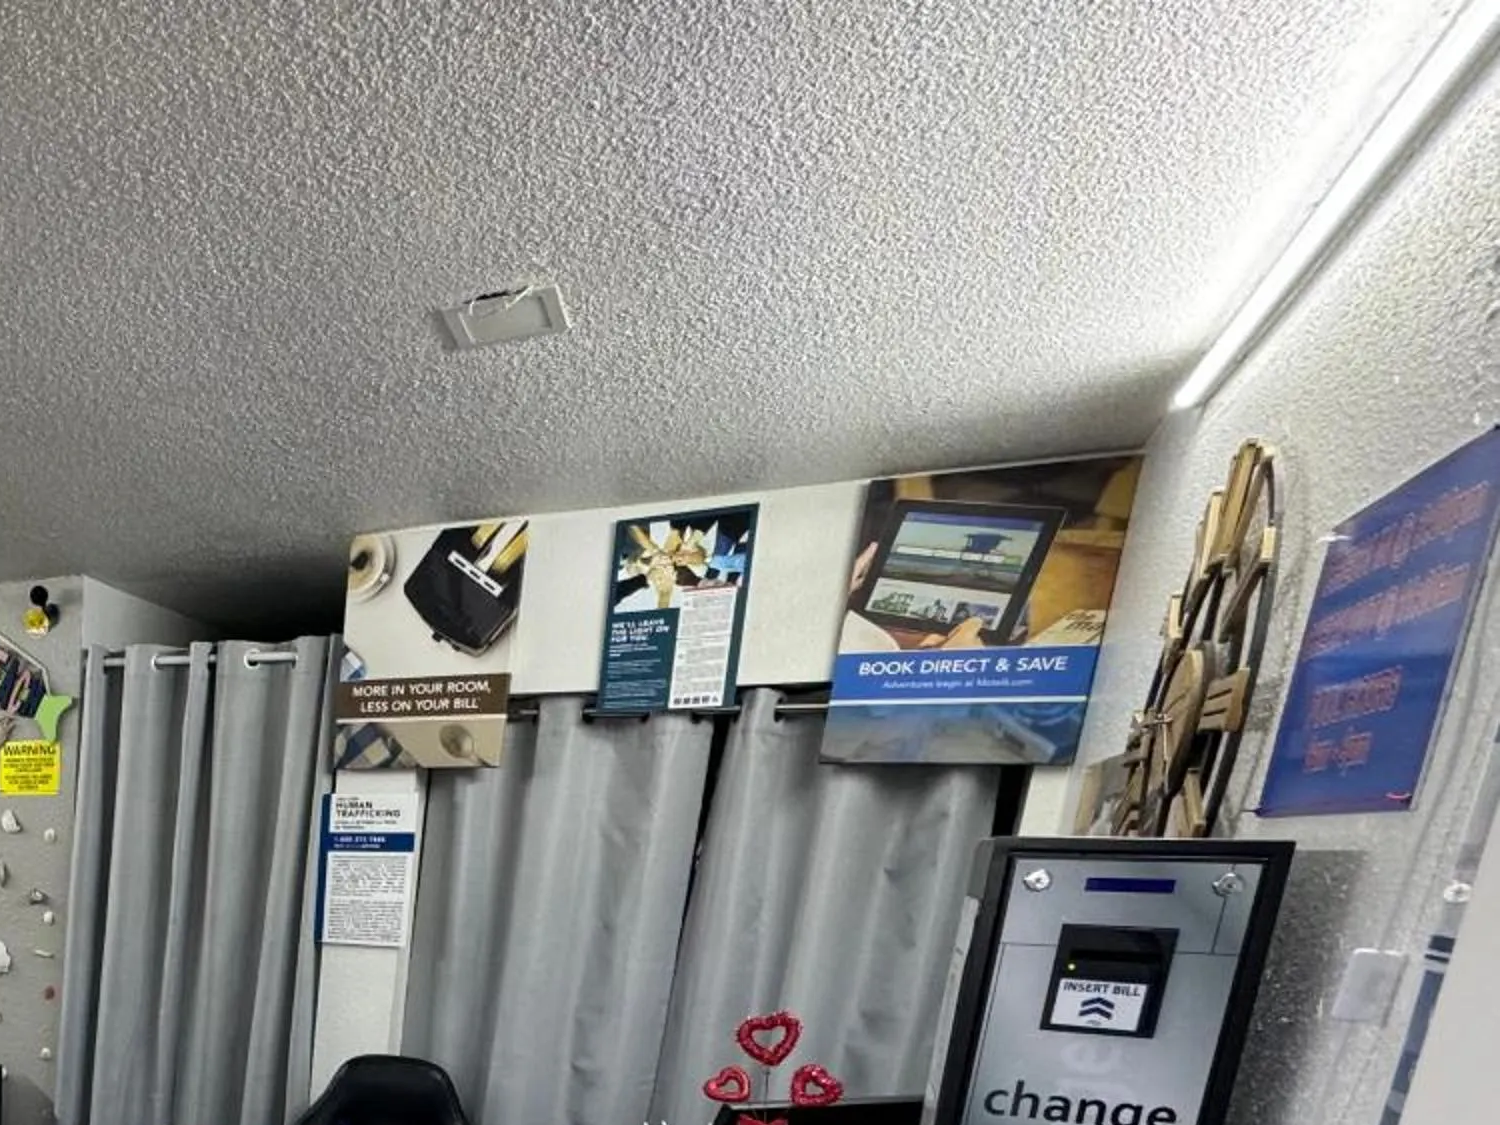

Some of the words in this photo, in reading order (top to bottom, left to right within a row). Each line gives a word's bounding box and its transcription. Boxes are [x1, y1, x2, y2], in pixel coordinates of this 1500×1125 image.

[858, 660, 914, 676] BOOK
[920, 658, 991, 674] DIRECT
[995, 658, 1009, 673] &
[1016, 655, 1069, 672] SAVE
[352, 685, 388, 697] MORE
[391, 685, 405, 696] IN
[408, 683, 443, 695] YOUR
[446, 680, 491, 694] ROOM,
[360, 701, 389, 713] LESS
[391, 700, 412, 712] ON
[415, 699, 450, 711] YOUR
[453, 697, 479, 709] BILL
[4, 744, 56, 756] WARNING
[336, 801, 372, 809] HUMAN
[336, 809, 400, 817] TRAFFICKING
[1063, 982, 1110, 993] INSERT
[1112, 985, 1141, 997] BILL
